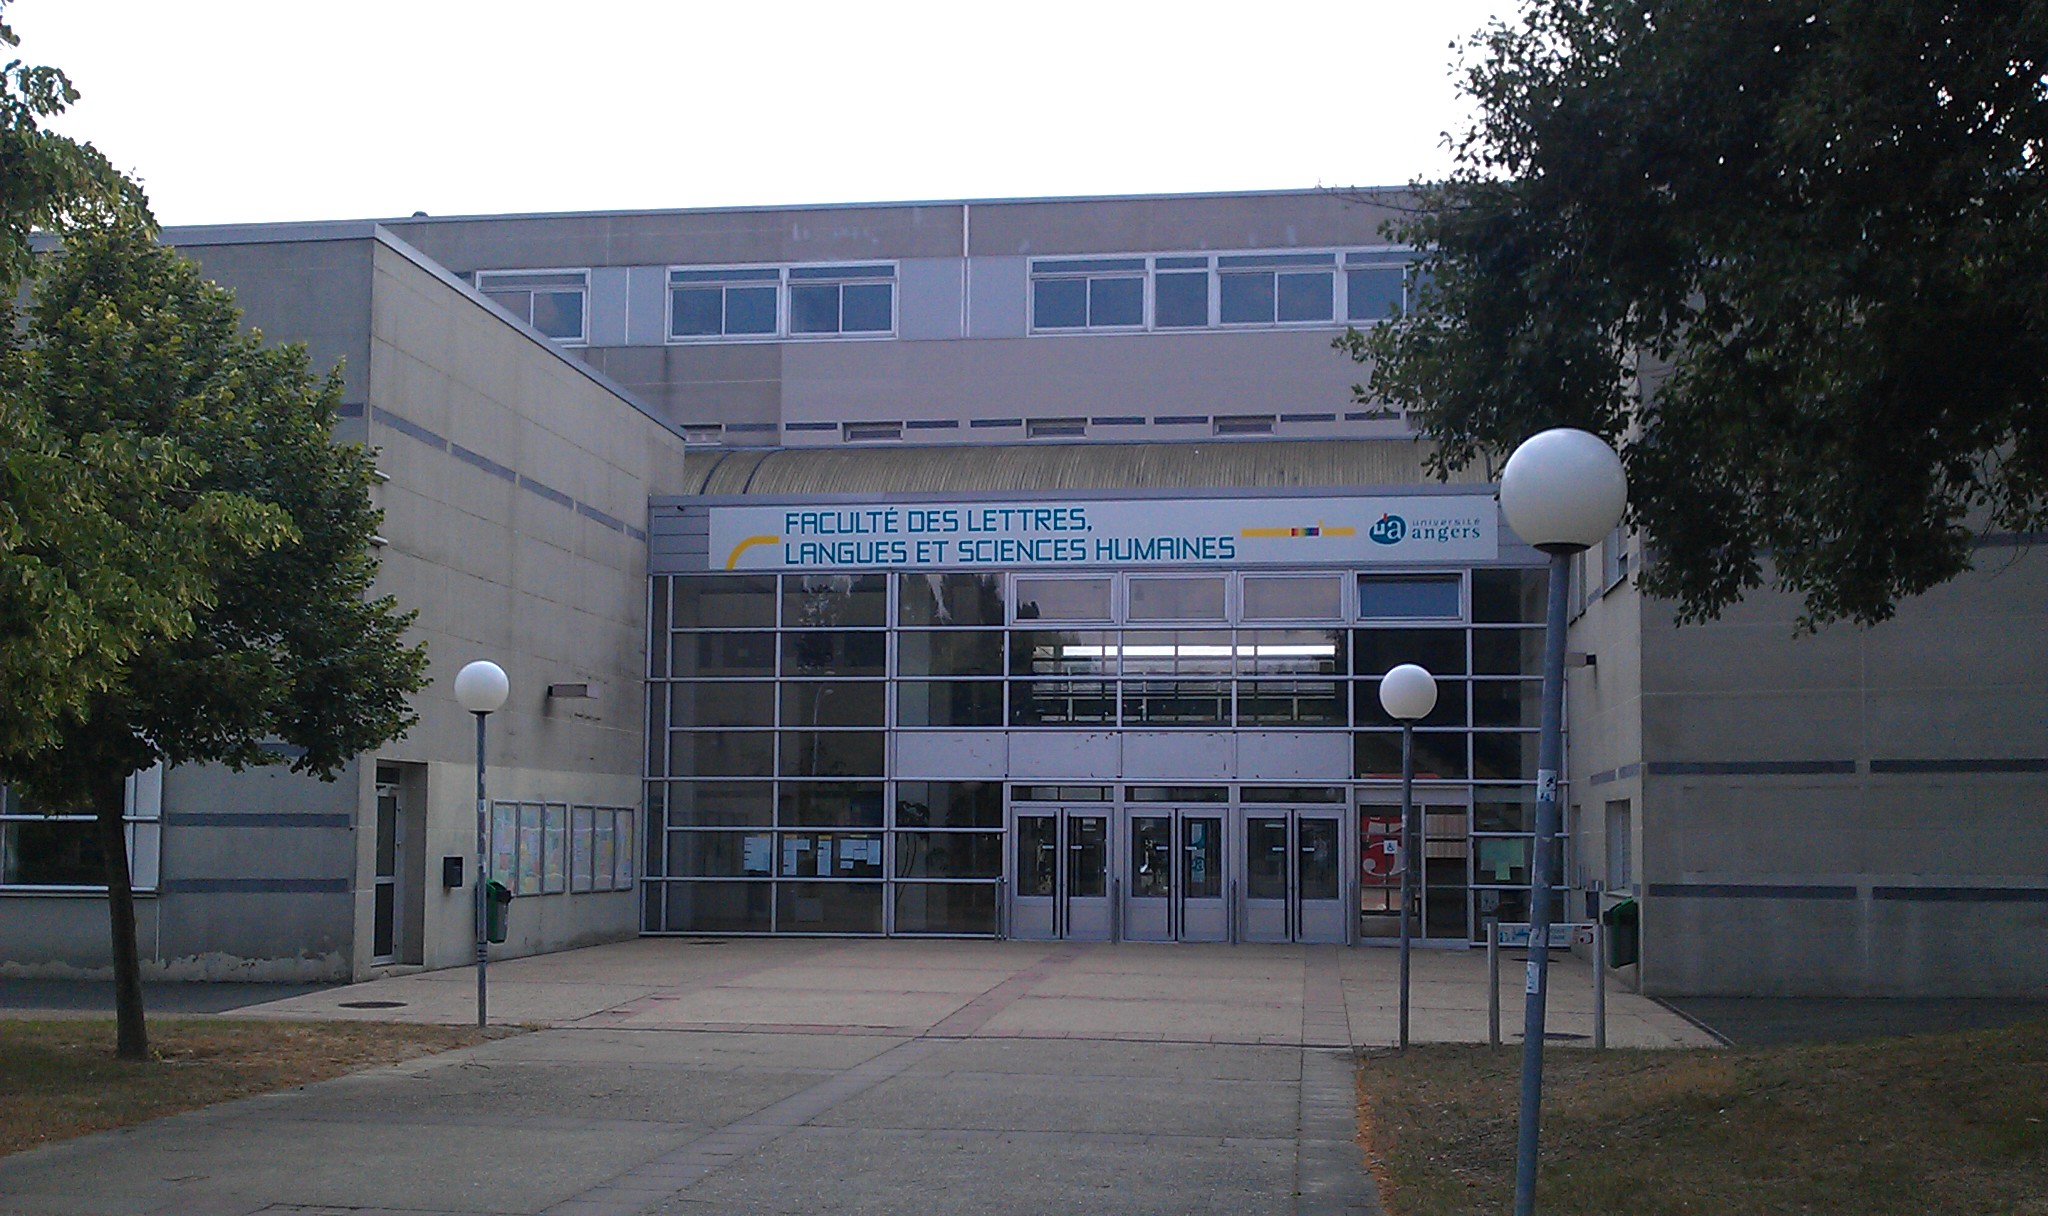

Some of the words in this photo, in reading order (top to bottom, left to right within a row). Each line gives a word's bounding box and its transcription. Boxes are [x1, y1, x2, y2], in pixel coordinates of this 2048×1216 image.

[785, 507, 899, 535] FACULTÉ
[908, 510, 959, 533] DES
[967, 508, 1093, 533] LETTRES,
[1412, 518, 1480, 526] université
[1411, 526, 1480, 542] angers
[785, 541, 907, 565] LANGUES
[916, 540, 949, 563] ET
[958, 539, 1087, 562] SCIENCES
[1096, 536, 1236, 561] HUMAINES
